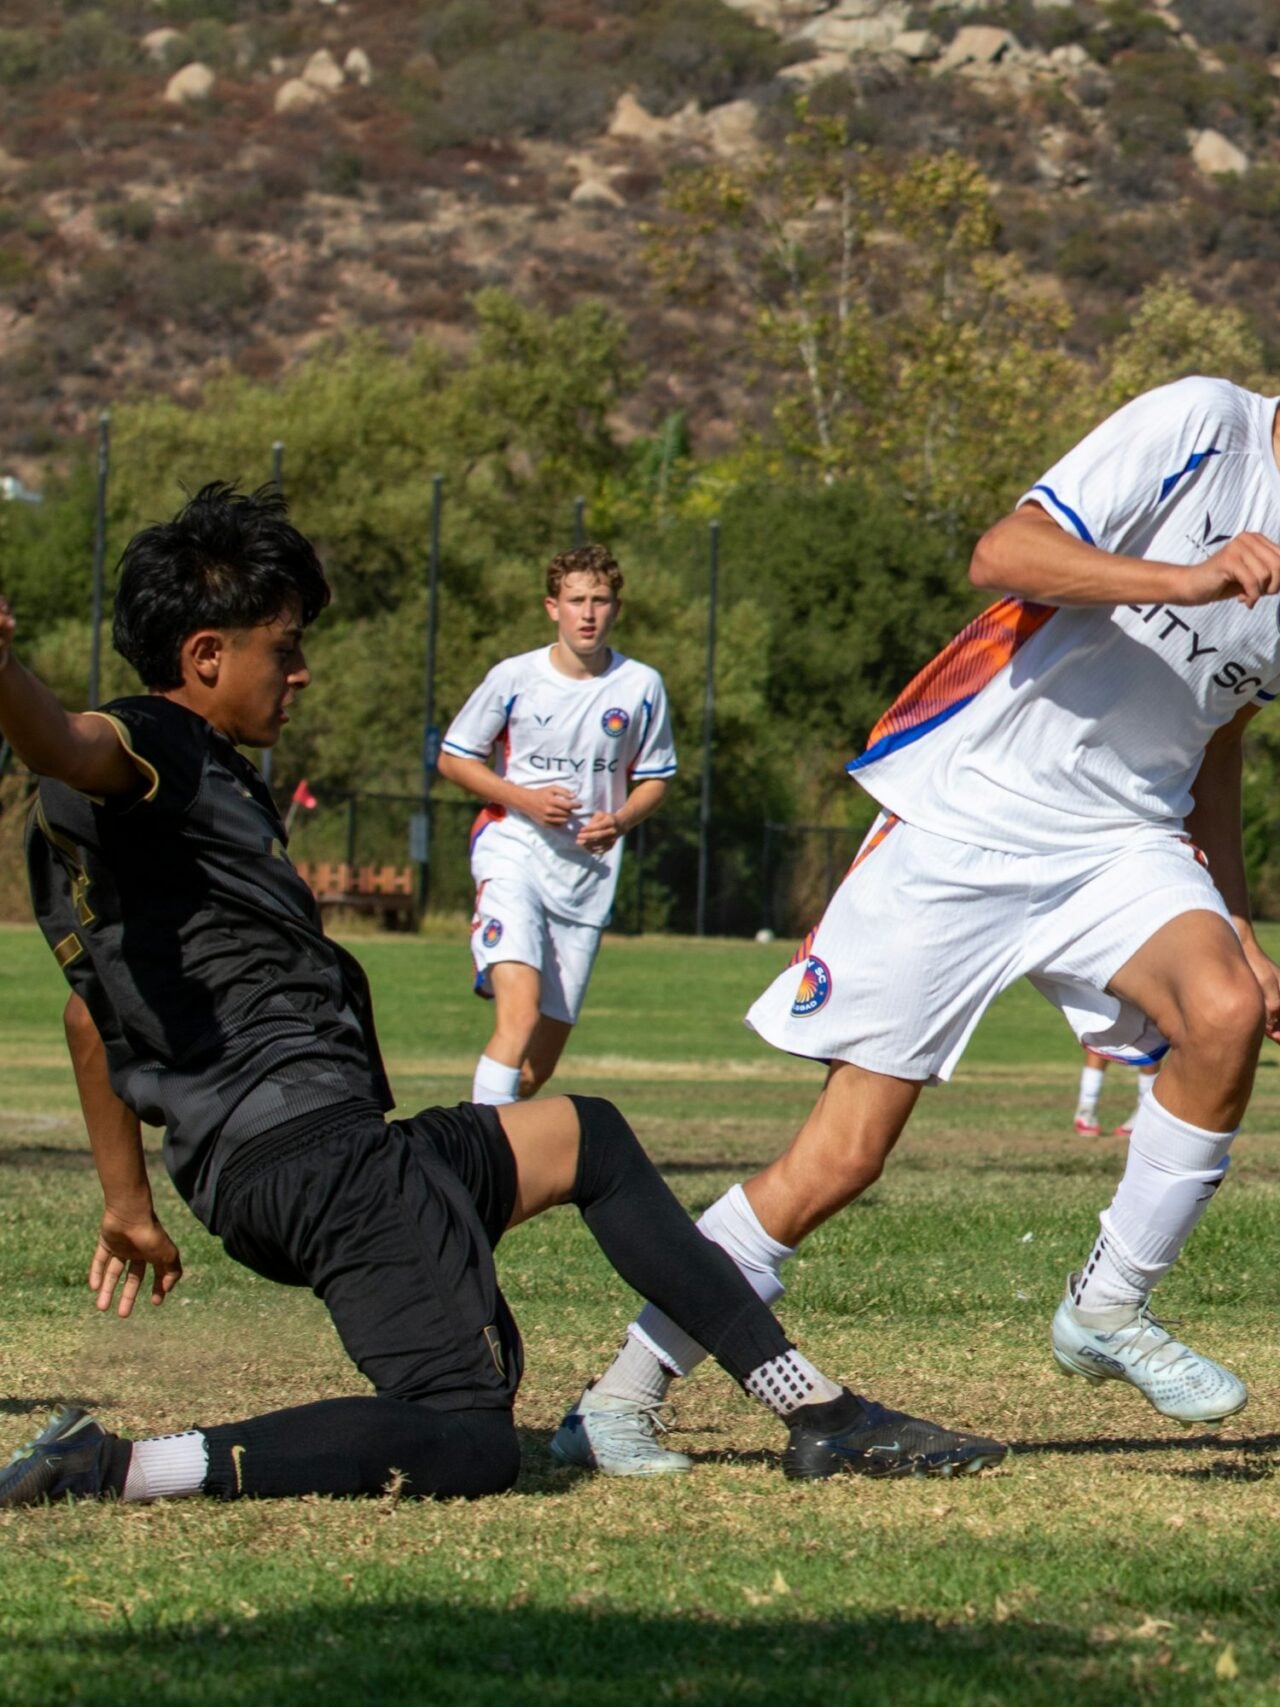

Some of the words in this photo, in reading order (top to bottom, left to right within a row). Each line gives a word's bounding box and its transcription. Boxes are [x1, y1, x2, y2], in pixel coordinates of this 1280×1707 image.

[1213, 661, 1262, 695] SC
[529, 754, 585, 773] CITY
[593, 757, 619, 773] SC
[814, 966, 827, 985] SC
